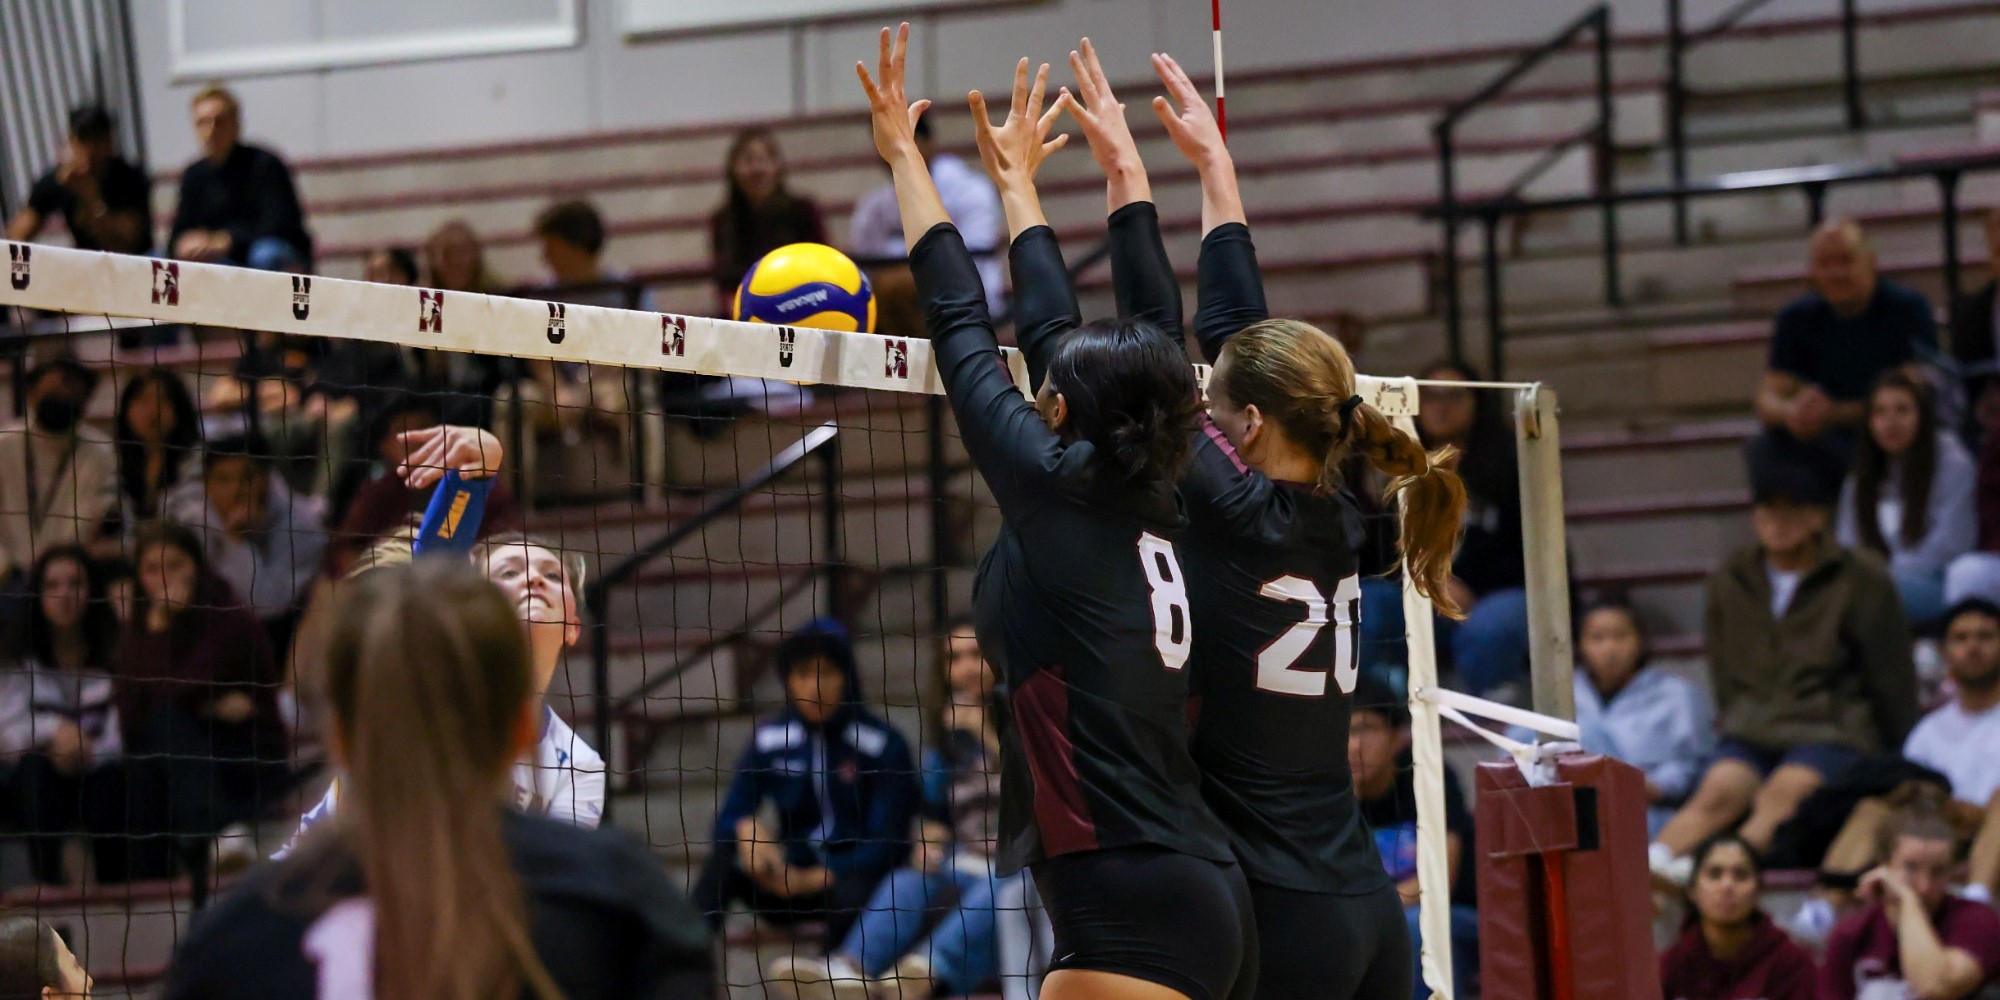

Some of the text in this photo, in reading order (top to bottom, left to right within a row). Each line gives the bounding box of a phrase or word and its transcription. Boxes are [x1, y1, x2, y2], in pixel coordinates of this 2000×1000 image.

[12, 263, 30, 273] SPORTS
[293, 294, 310, 303] SPORTS
[548, 318, 566, 328] SPORTS
[779, 342, 794, 352] SPORTS
[1137, 529, 1192, 671] 8
[1256, 573, 1361, 697] 20
